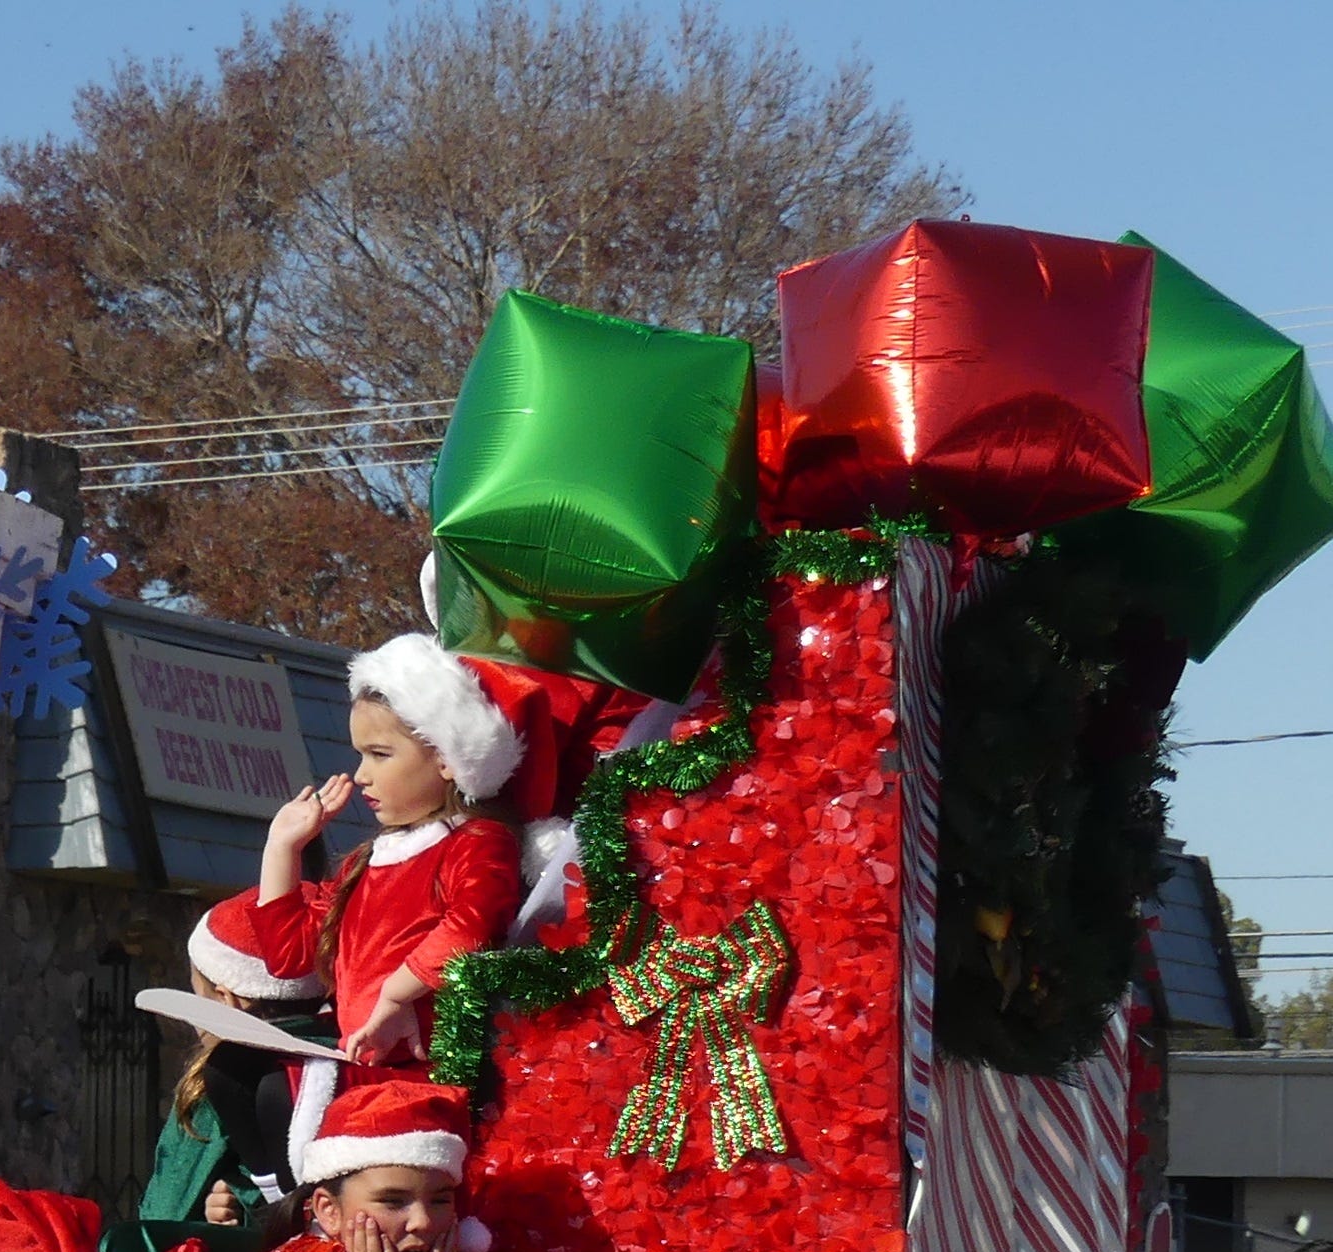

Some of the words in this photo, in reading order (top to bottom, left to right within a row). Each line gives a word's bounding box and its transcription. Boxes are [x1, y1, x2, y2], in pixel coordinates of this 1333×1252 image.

[130, 655, 226, 724] CHEAPEST
[225, 676, 282, 732] COLD
[153, 727, 211, 788] BEER
[203, 738, 235, 792] IN
[229, 744, 293, 801] TOWN
